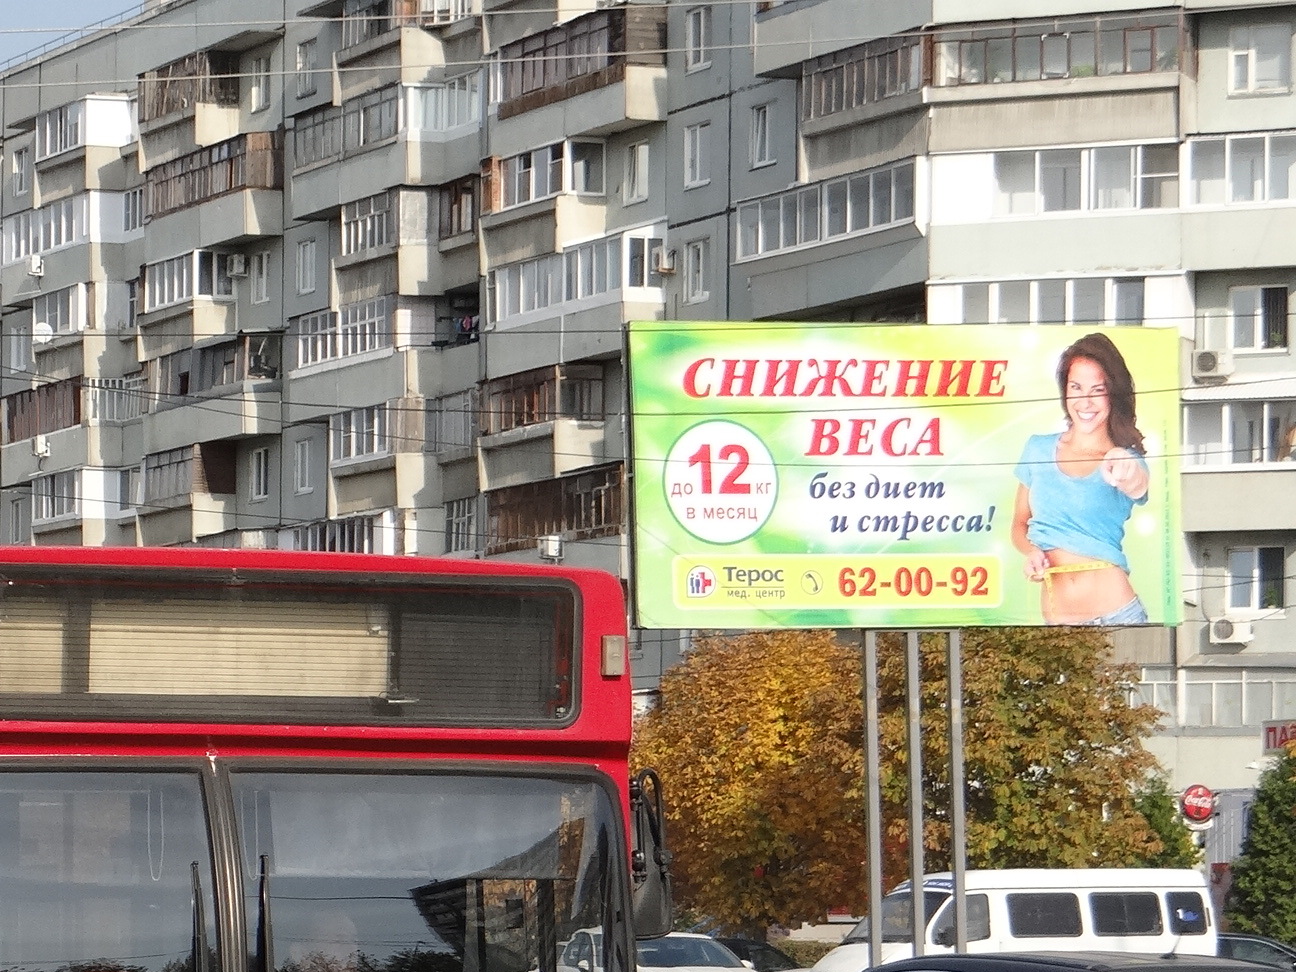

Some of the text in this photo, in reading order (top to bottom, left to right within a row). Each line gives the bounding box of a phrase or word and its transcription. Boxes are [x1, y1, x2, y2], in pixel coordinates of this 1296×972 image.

[682, 357, 1008, 398] СНИЖЕНИЕ
[804, 417, 944, 457] ВЕСА
[671, 444, 771, 497] до 12 кг
[808, 472, 945, 499] без диет
[686, 507, 758, 522] в месяц
[829, 506, 996, 541] и стресса!
[723, 566, 784, 586] Терос
[838, 567, 989, 597] 62-00-92
[727, 589, 785, 600] мед. центр
